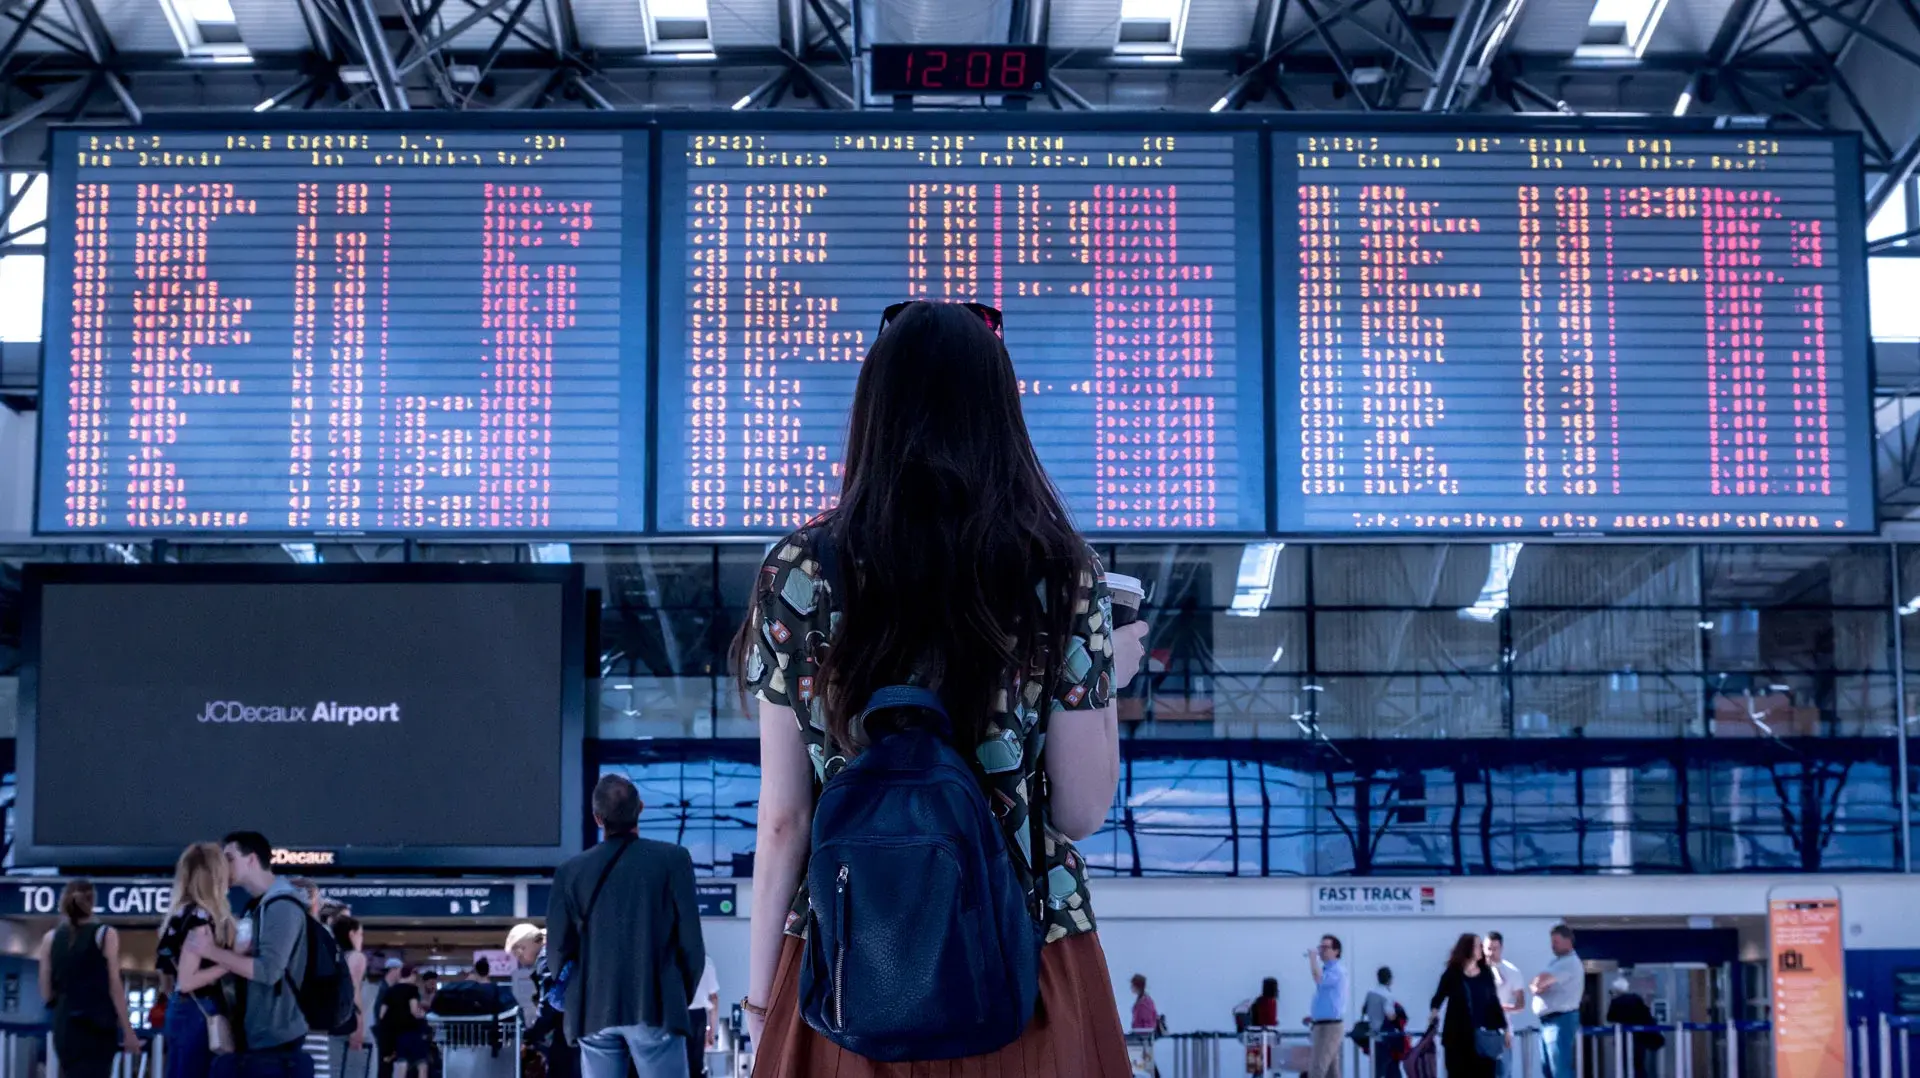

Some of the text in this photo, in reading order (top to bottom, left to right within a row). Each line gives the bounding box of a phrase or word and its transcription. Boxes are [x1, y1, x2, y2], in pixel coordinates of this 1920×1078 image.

[197, 701, 400, 726] JCDecaux Airport
[19, 886, 55, 913] TO
[108, 886, 171, 913] GATE
[349, 887, 387, 898] PASSPORT
[388, 887, 404, 898] AND
[405, 887, 444, 898] BOARDING
[1319, 887, 1355, 901] FAST
[1361, 887, 1413, 901] TRACK
